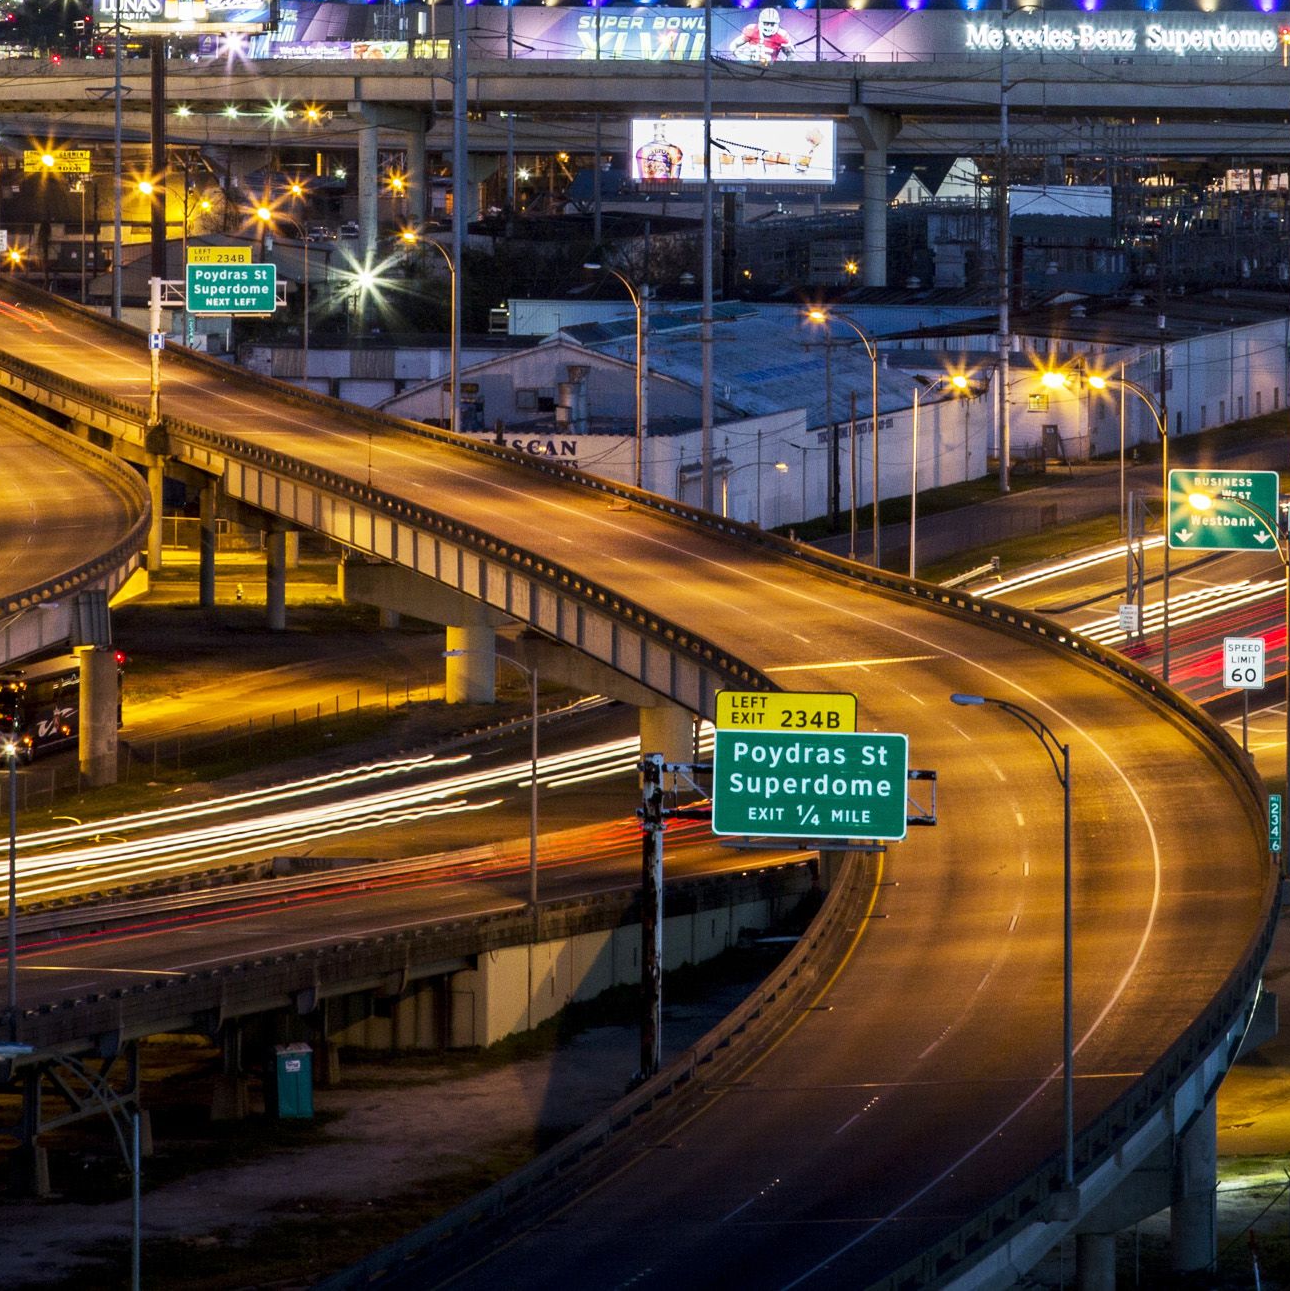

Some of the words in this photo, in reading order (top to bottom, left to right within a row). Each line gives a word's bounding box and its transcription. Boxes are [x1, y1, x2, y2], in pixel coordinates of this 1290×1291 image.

[577, 16, 643, 29] SUPER
[653, 16, 707, 29] BOWL
[1146, 24, 1277, 55] Superdome
[217, 254, 245, 263] 234B
[195, 270, 248, 282] Poydras
[254, 270, 267, 280] St
[194, 284, 269, 296] Superdome
[205, 298, 230, 306] NEXT
[234, 298, 257, 306] LEFT
[1194, 477, 1254, 487] BUSINESS
[1221, 489, 1252, 500] WEST
[1190, 514, 1257, 527] Westbank
[1228, 644, 1261, 653] SPEED
[1231, 655, 1256, 664] LIMIT
[1231, 668, 1257, 682] 60
[731, 696, 768, 709] LEFT
[731, 712, 765, 724] EXIT
[780, 710, 841, 729] 234B
[733, 742, 846, 768] Poydras
[861, 745, 888, 766] St
[729, 773, 892, 798] Superdome
[748, 807, 785, 820] EXIT
[831, 810, 871, 823] MILE
